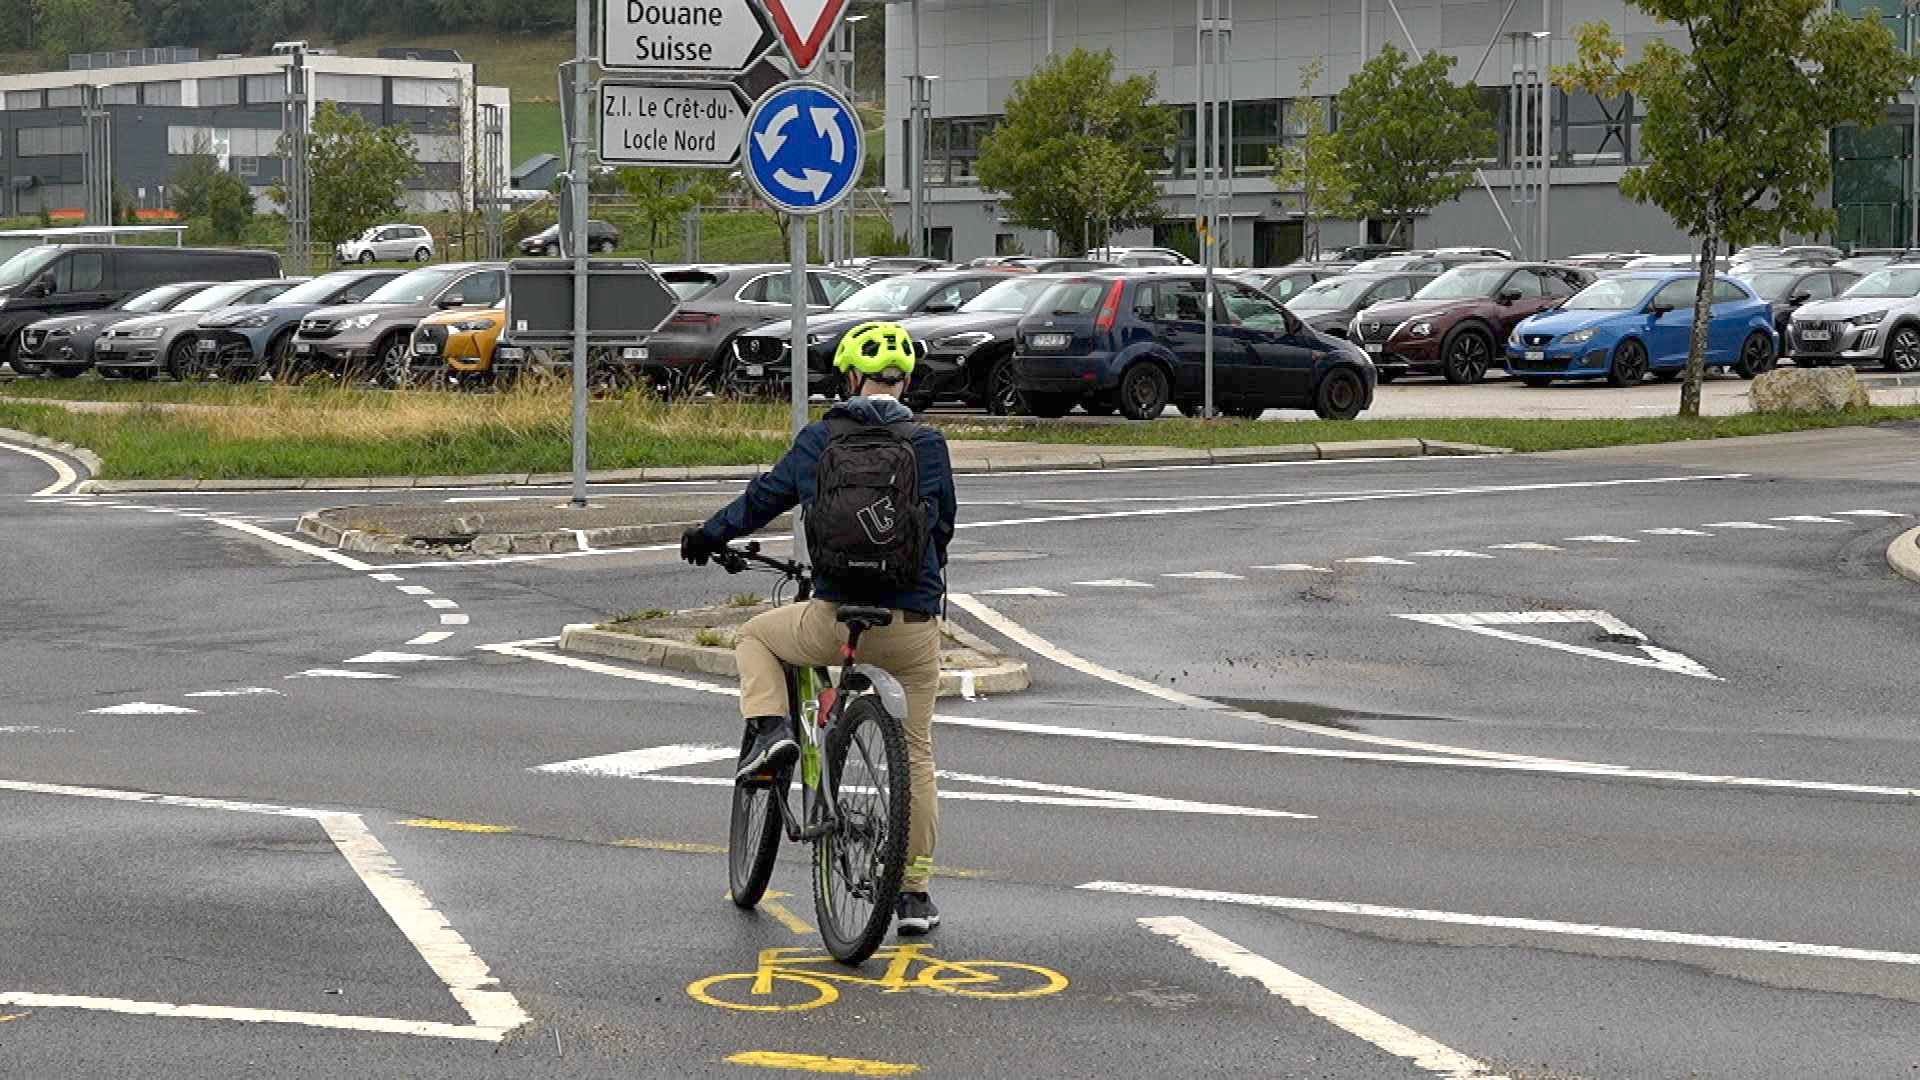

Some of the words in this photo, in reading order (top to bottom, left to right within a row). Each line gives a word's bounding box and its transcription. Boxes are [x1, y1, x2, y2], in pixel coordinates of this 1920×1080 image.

[626, 0, 723, 27] Douane
[636, 36, 712, 61] Suisse
[605, 96, 632, 117] Z.I.
[639, 97, 657, 117] Le
[663, 97, 734, 120] Crêt-du-
[624, 129, 667, 151] Locle
[674, 130, 716, 151] Nord
